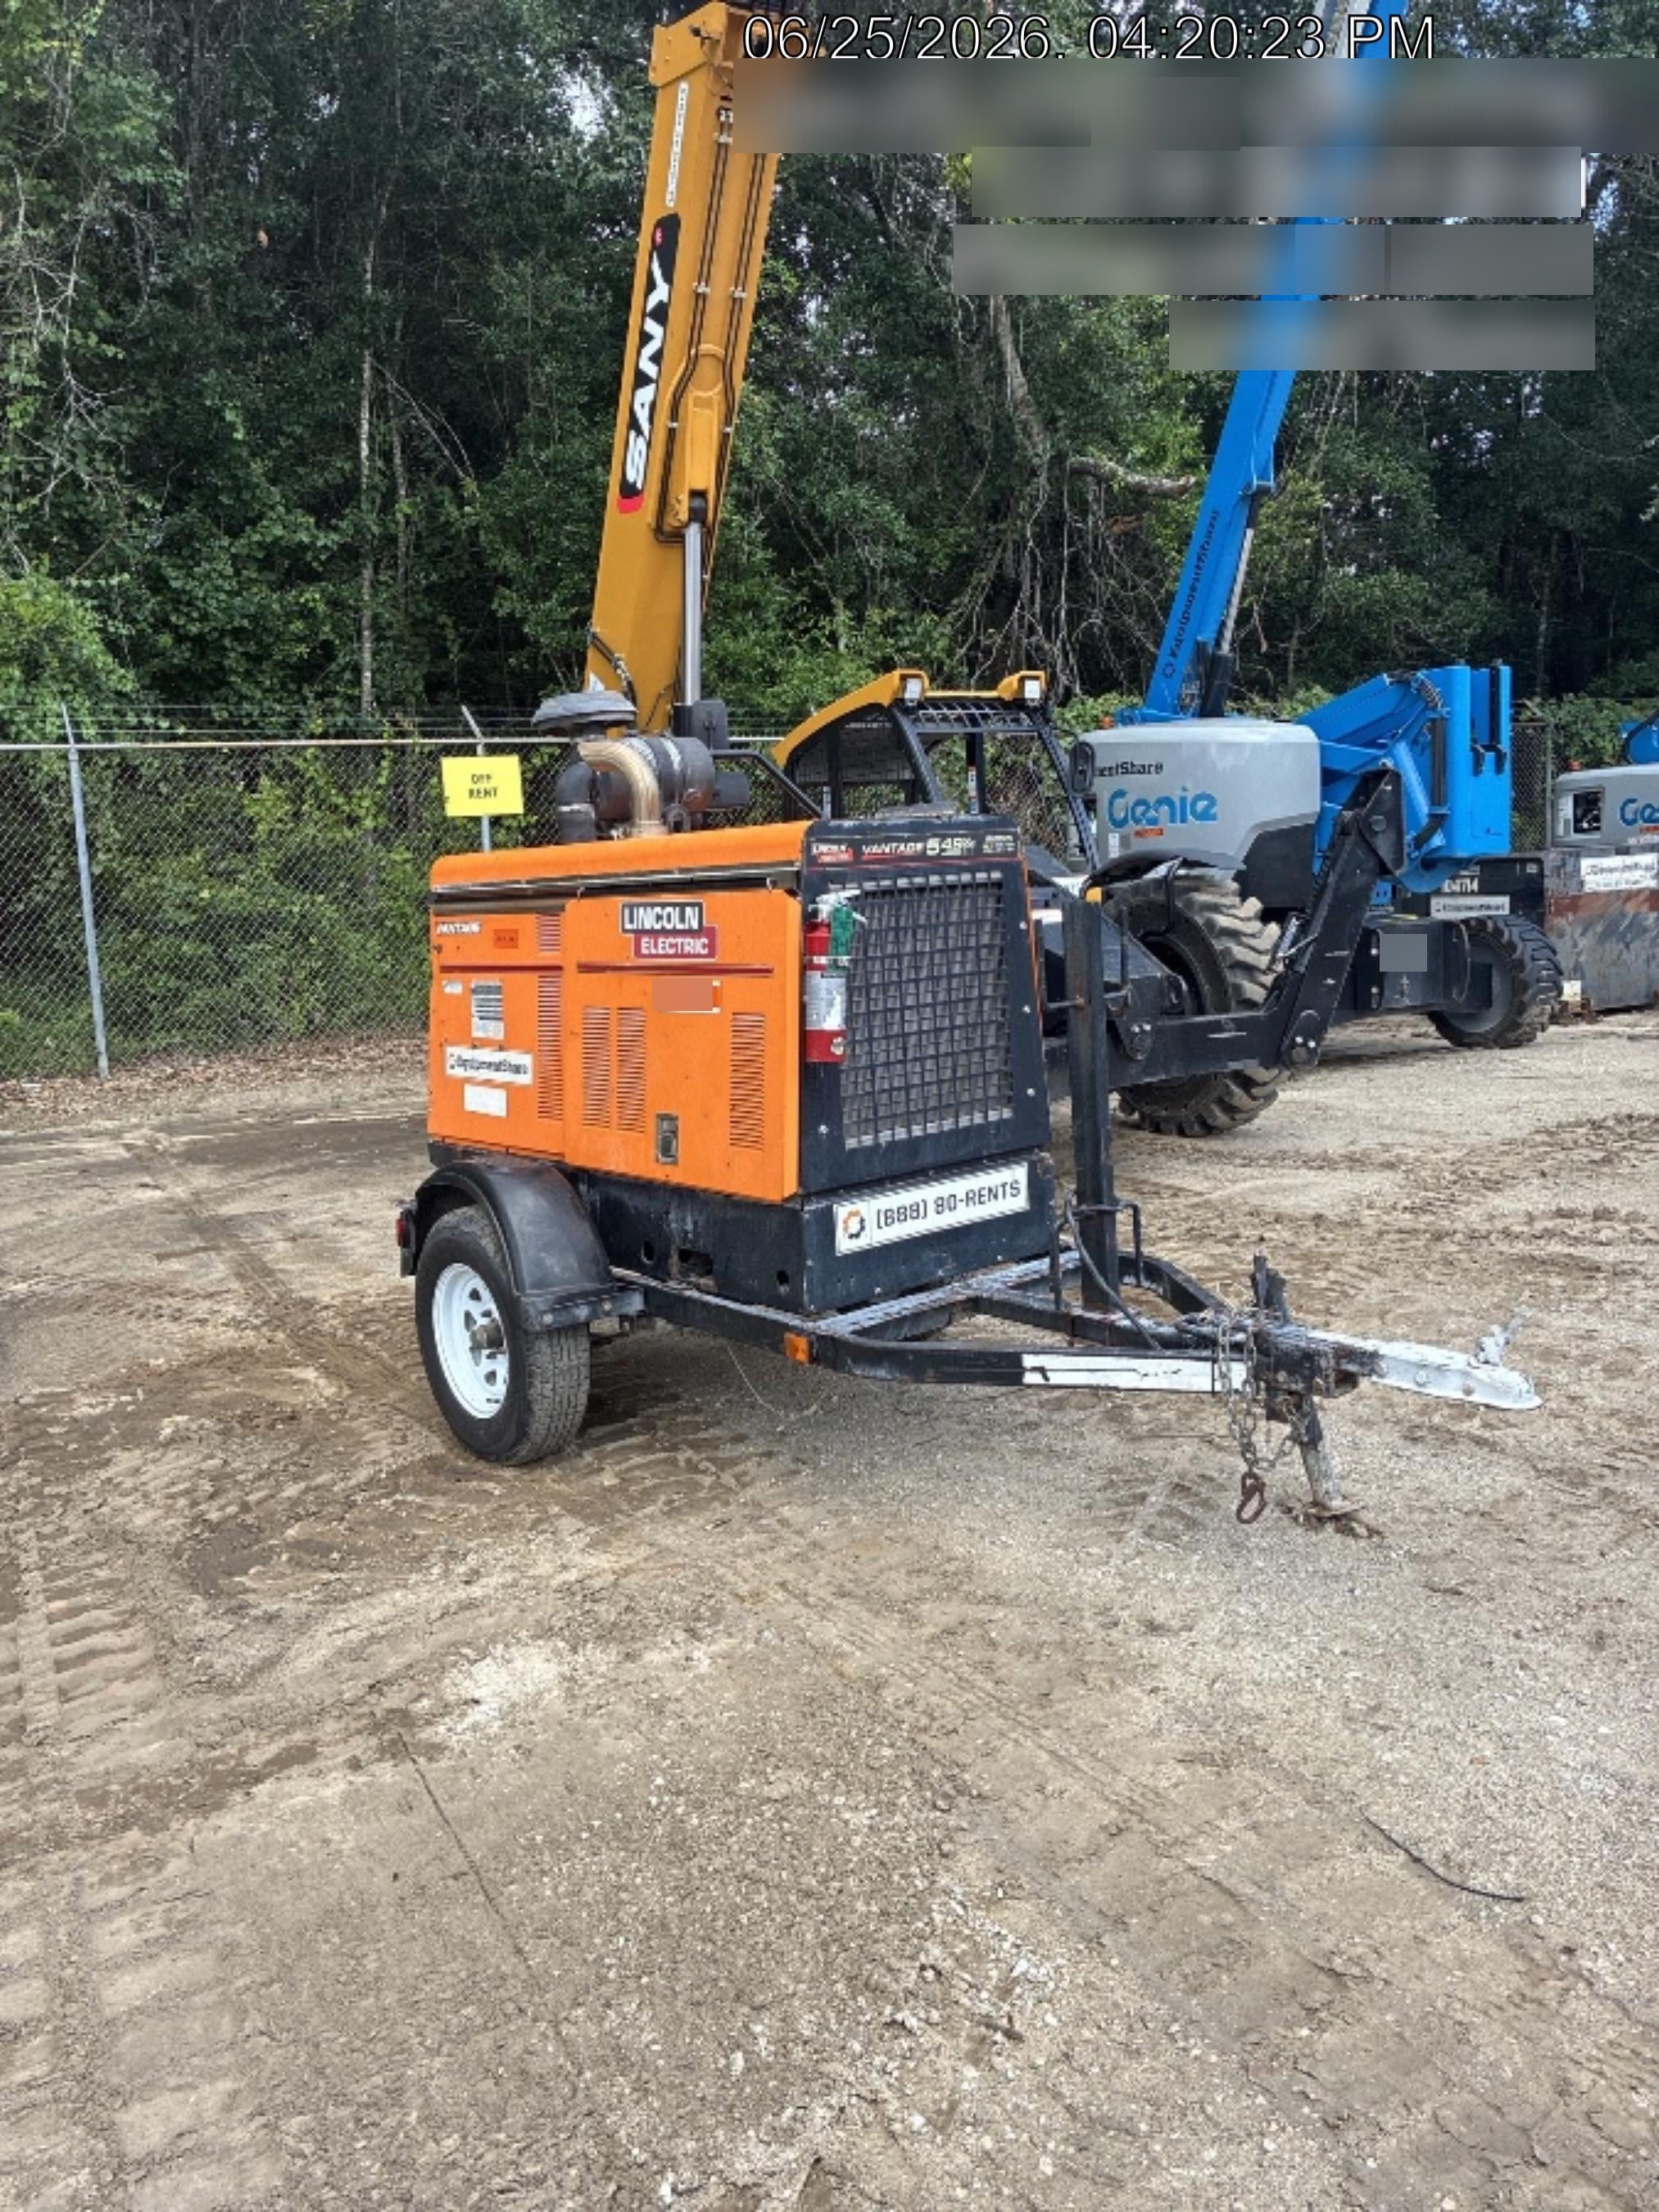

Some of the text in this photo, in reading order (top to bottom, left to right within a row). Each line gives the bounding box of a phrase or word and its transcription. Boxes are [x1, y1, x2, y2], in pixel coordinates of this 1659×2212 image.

[625, 250, 670, 490] SANY
[468, 786, 498, 800] RENT
[1108, 786, 1218, 829] Genie
[623, 905, 700, 930] LINCOLN
[641, 936, 709, 954] ELECTRIC
[933, 1180, 1022, 1215] 80-RENTS
